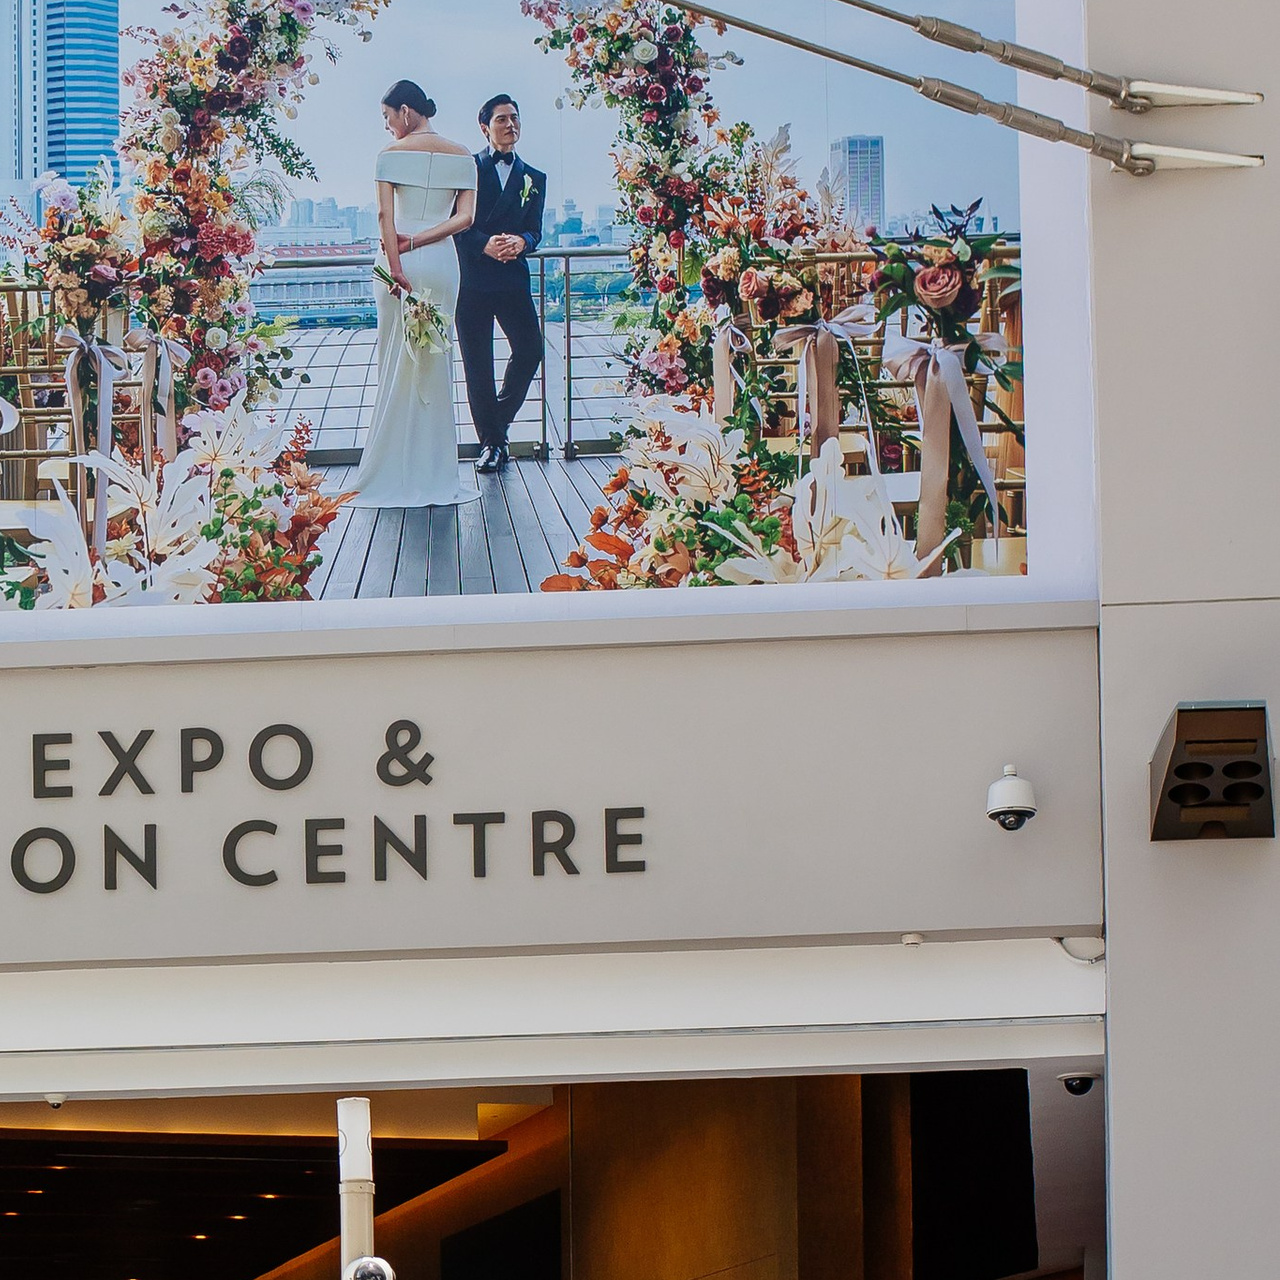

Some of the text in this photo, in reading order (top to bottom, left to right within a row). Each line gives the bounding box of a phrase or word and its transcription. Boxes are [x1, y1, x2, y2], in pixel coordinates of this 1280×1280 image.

[32, 723, 315, 800] EXPO
[375, 718, 436, 788] &
[221, 806, 649, 888] CENTRE
